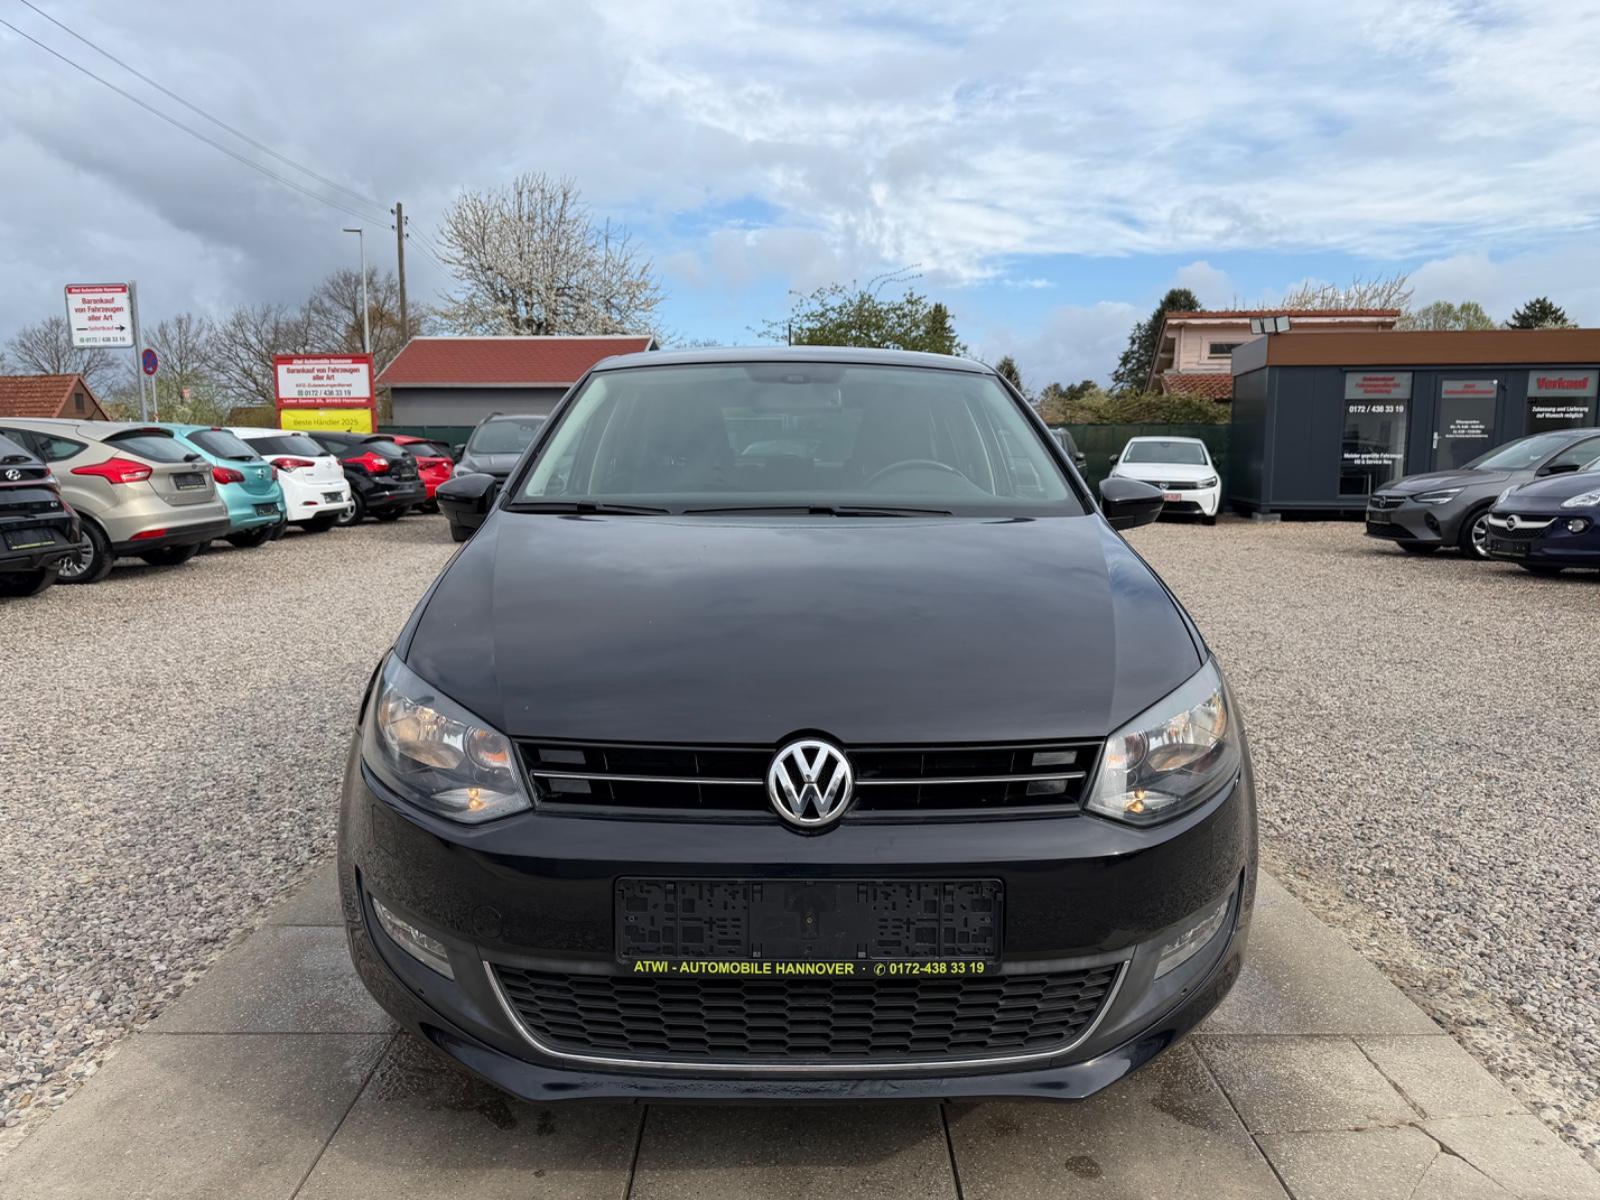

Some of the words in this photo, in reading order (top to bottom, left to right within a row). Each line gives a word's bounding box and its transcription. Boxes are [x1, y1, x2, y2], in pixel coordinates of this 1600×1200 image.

[1536, 376, 1589, 391] Verkauf
[1348, 405, 1366, 413] 0172
[1371, 405, 1384, 413] 438
[1385, 405, 1394, 413] 33
[768, 740, 853, 827] VW
[633, 960, 669, 973] ATWI
[679, 961, 773, 975] AUTOMOBILE
[775, 962, 855, 976] HANNOVER
[889, 962, 947, 975] 0172-438
[950, 962, 967, 974] 33
[969, 961, 985, 974] 19
